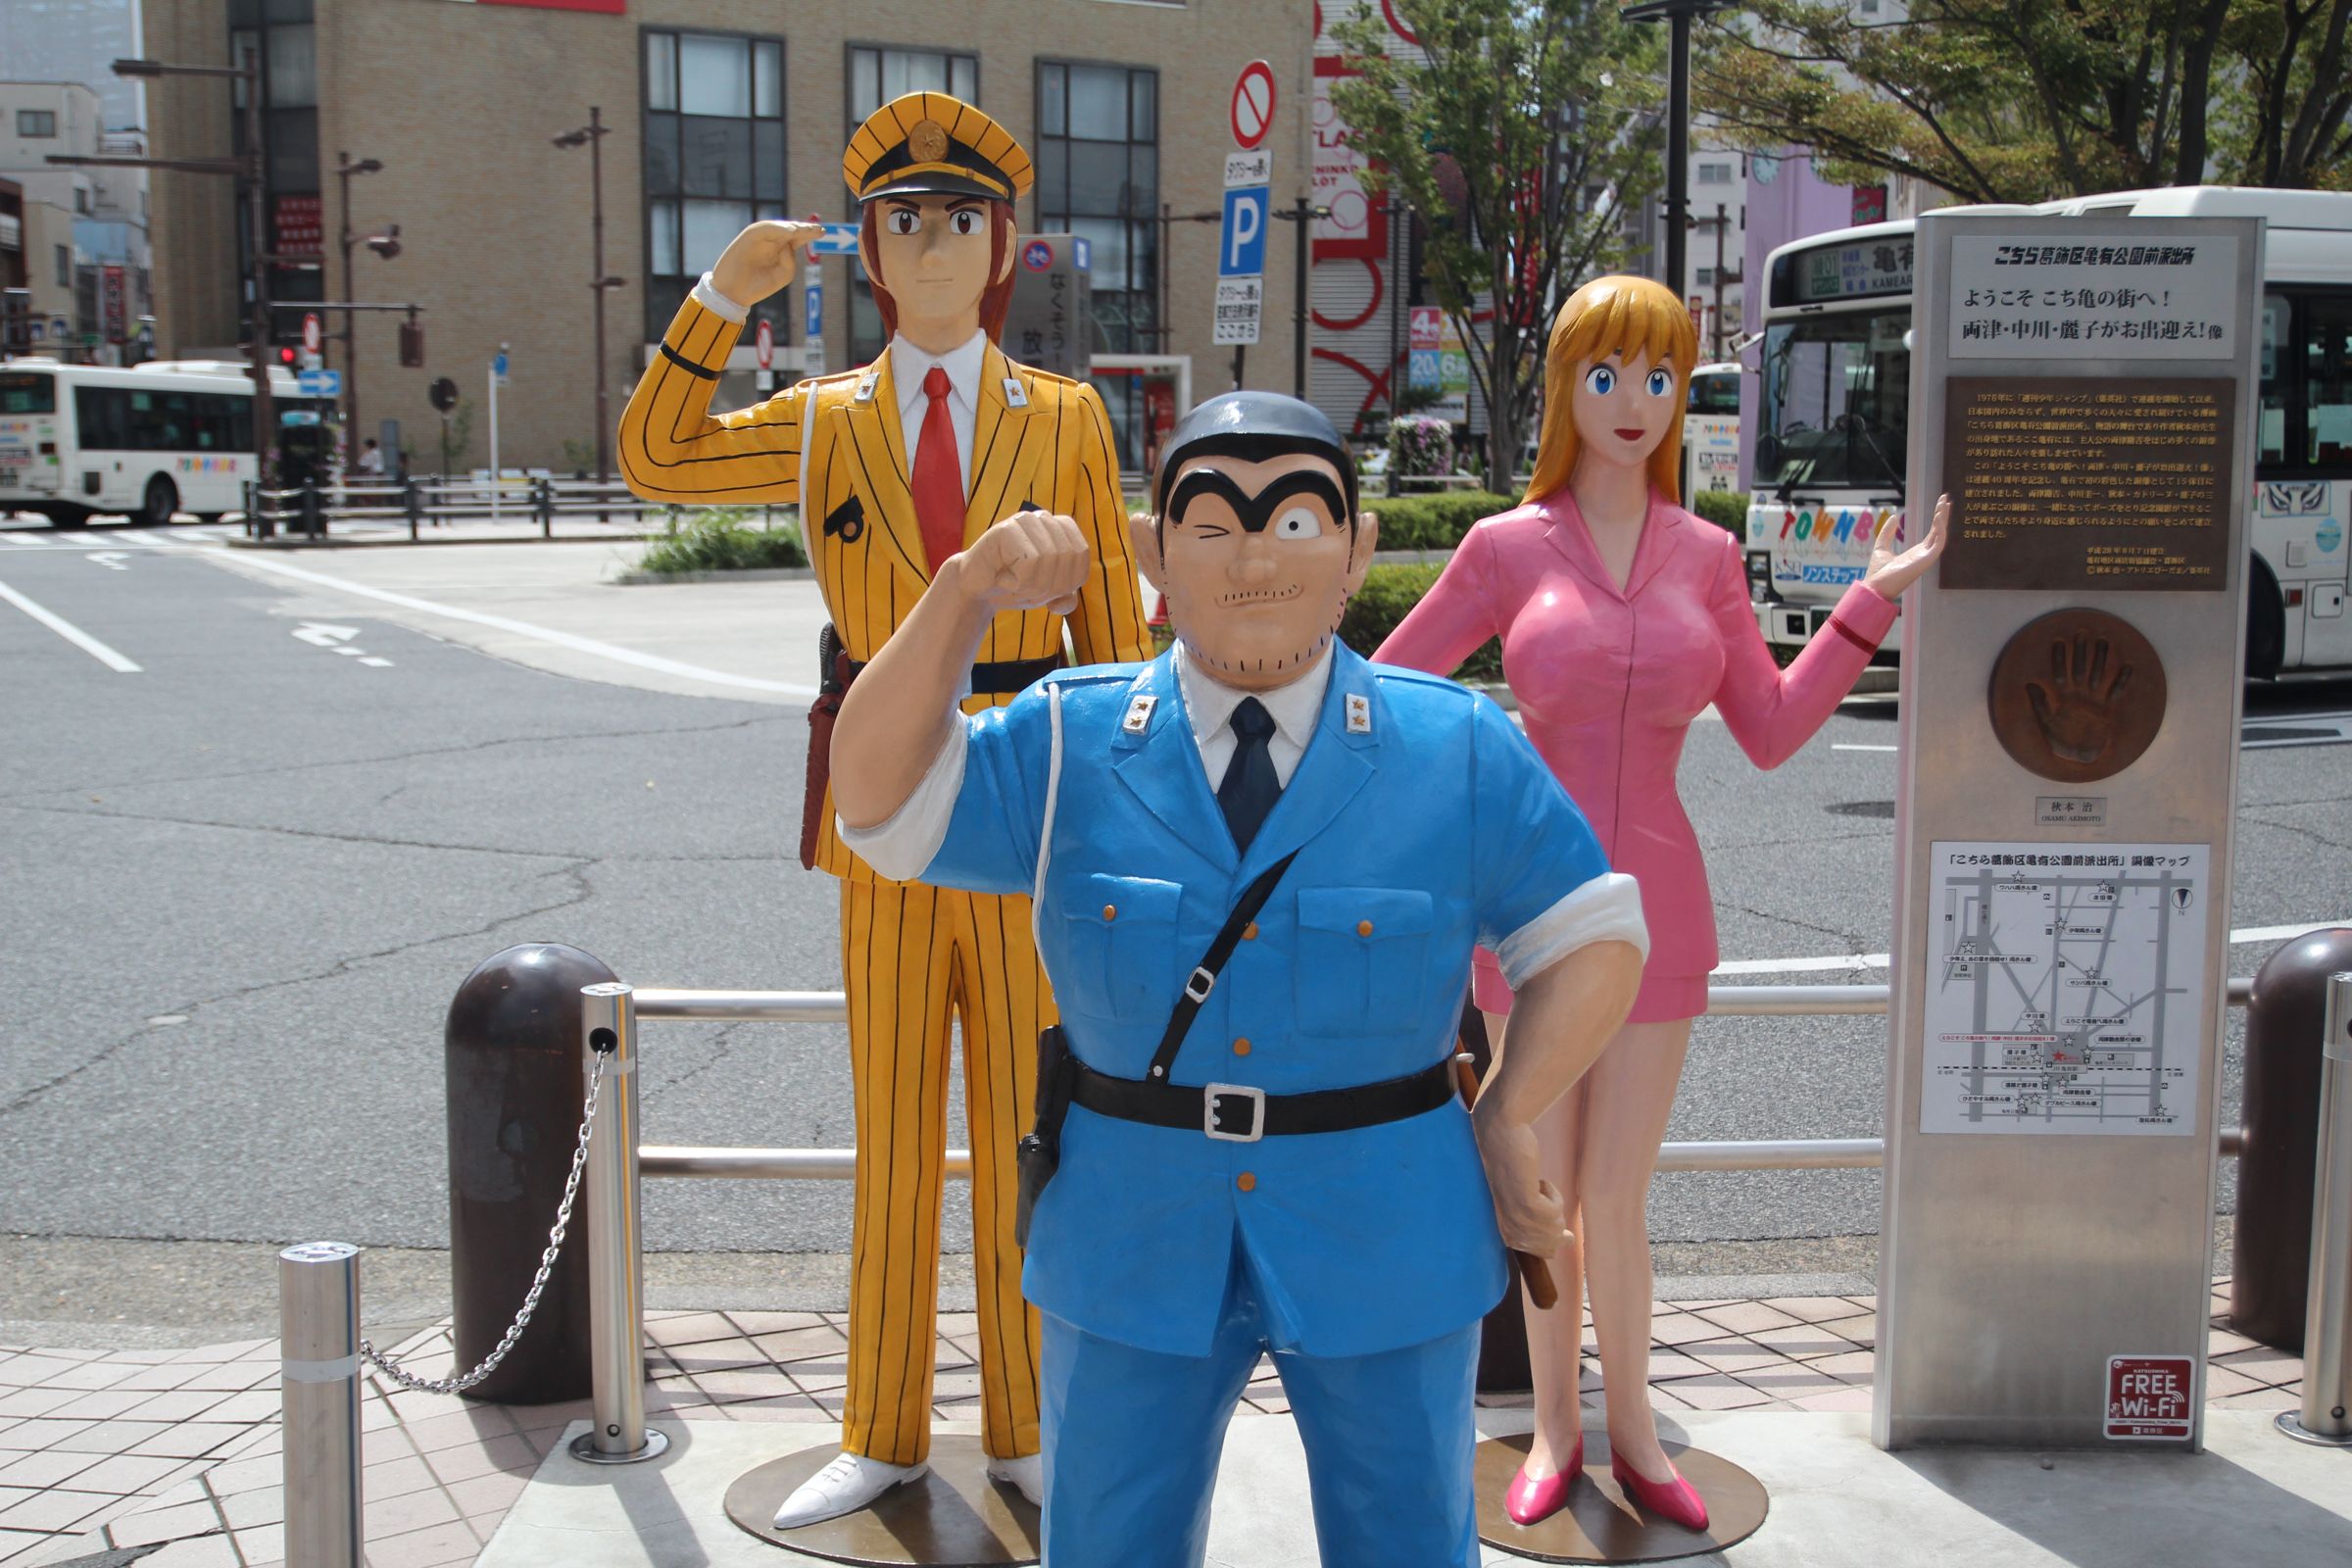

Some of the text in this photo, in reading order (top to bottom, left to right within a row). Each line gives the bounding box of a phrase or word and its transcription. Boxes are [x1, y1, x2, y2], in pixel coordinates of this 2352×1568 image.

[1230, 197, 1259, 268] P
[1994, 246, 2195, 266] こちら葛飾区亀有公園前派出所
[1963, 288, 2169, 309] ようこそ こち亀の街へ！
[2121, 1374, 2178, 1395] FREE
[2121, 1396, 2177, 1417] Wi-Fi
